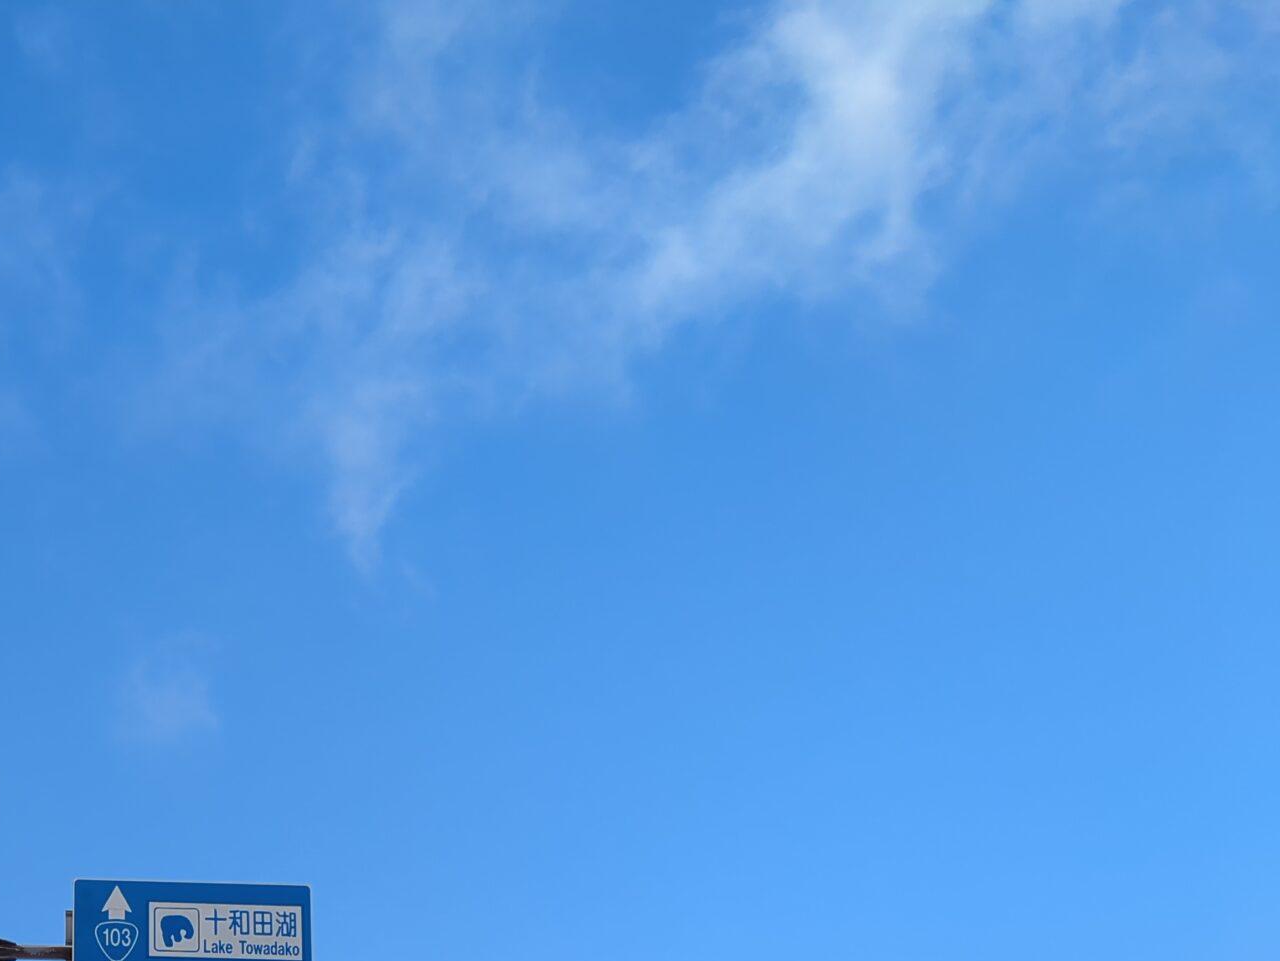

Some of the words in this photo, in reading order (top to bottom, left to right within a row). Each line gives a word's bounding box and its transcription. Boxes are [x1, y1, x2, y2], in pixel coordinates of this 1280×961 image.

[205, 909, 297, 938] 十和田湖
[103, 928, 131, 946] 103
[203, 940, 233, 954] Lake
[239, 941, 300, 956] Towadako
